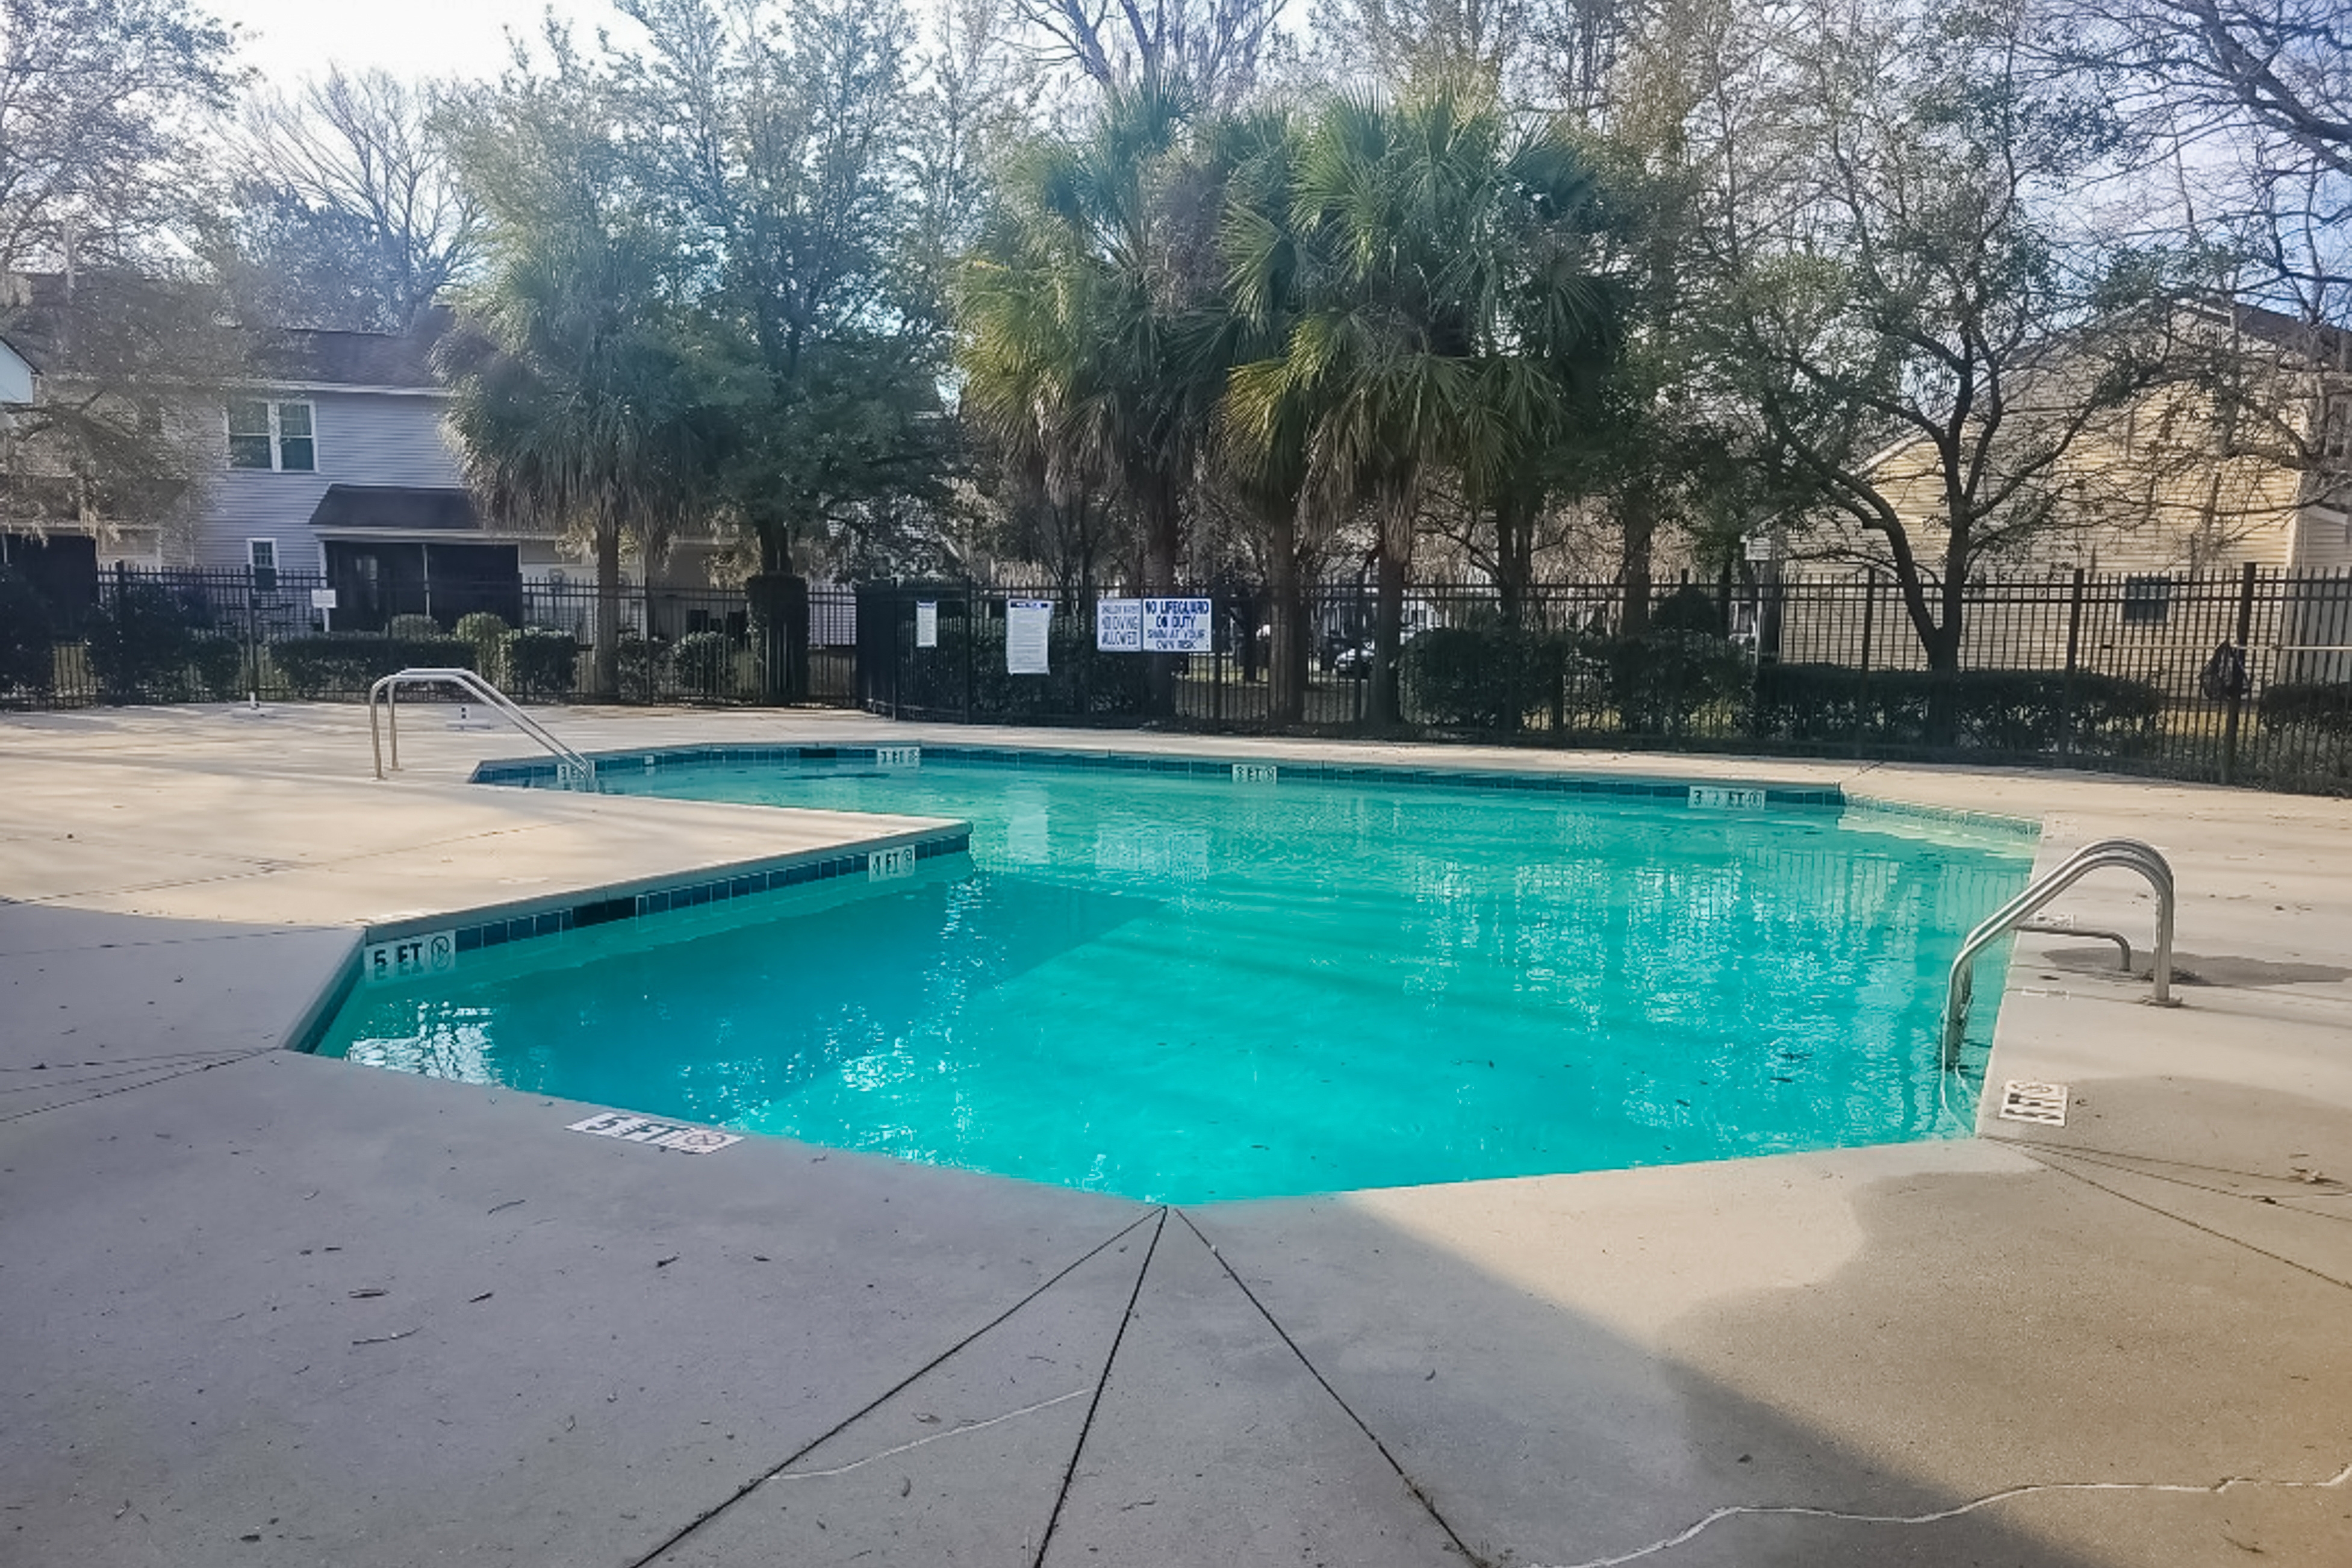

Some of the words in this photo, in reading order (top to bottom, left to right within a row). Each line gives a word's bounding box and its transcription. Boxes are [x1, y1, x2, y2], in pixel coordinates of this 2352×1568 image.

[1145, 601, 1157, 614] NO
[1160, 601, 1209, 614] LIFEGUARD
[1172, 616, 1196, 627] DUTY
[1102, 631, 1137, 645] ALLOWED
[397, 942, 423, 963] FT
